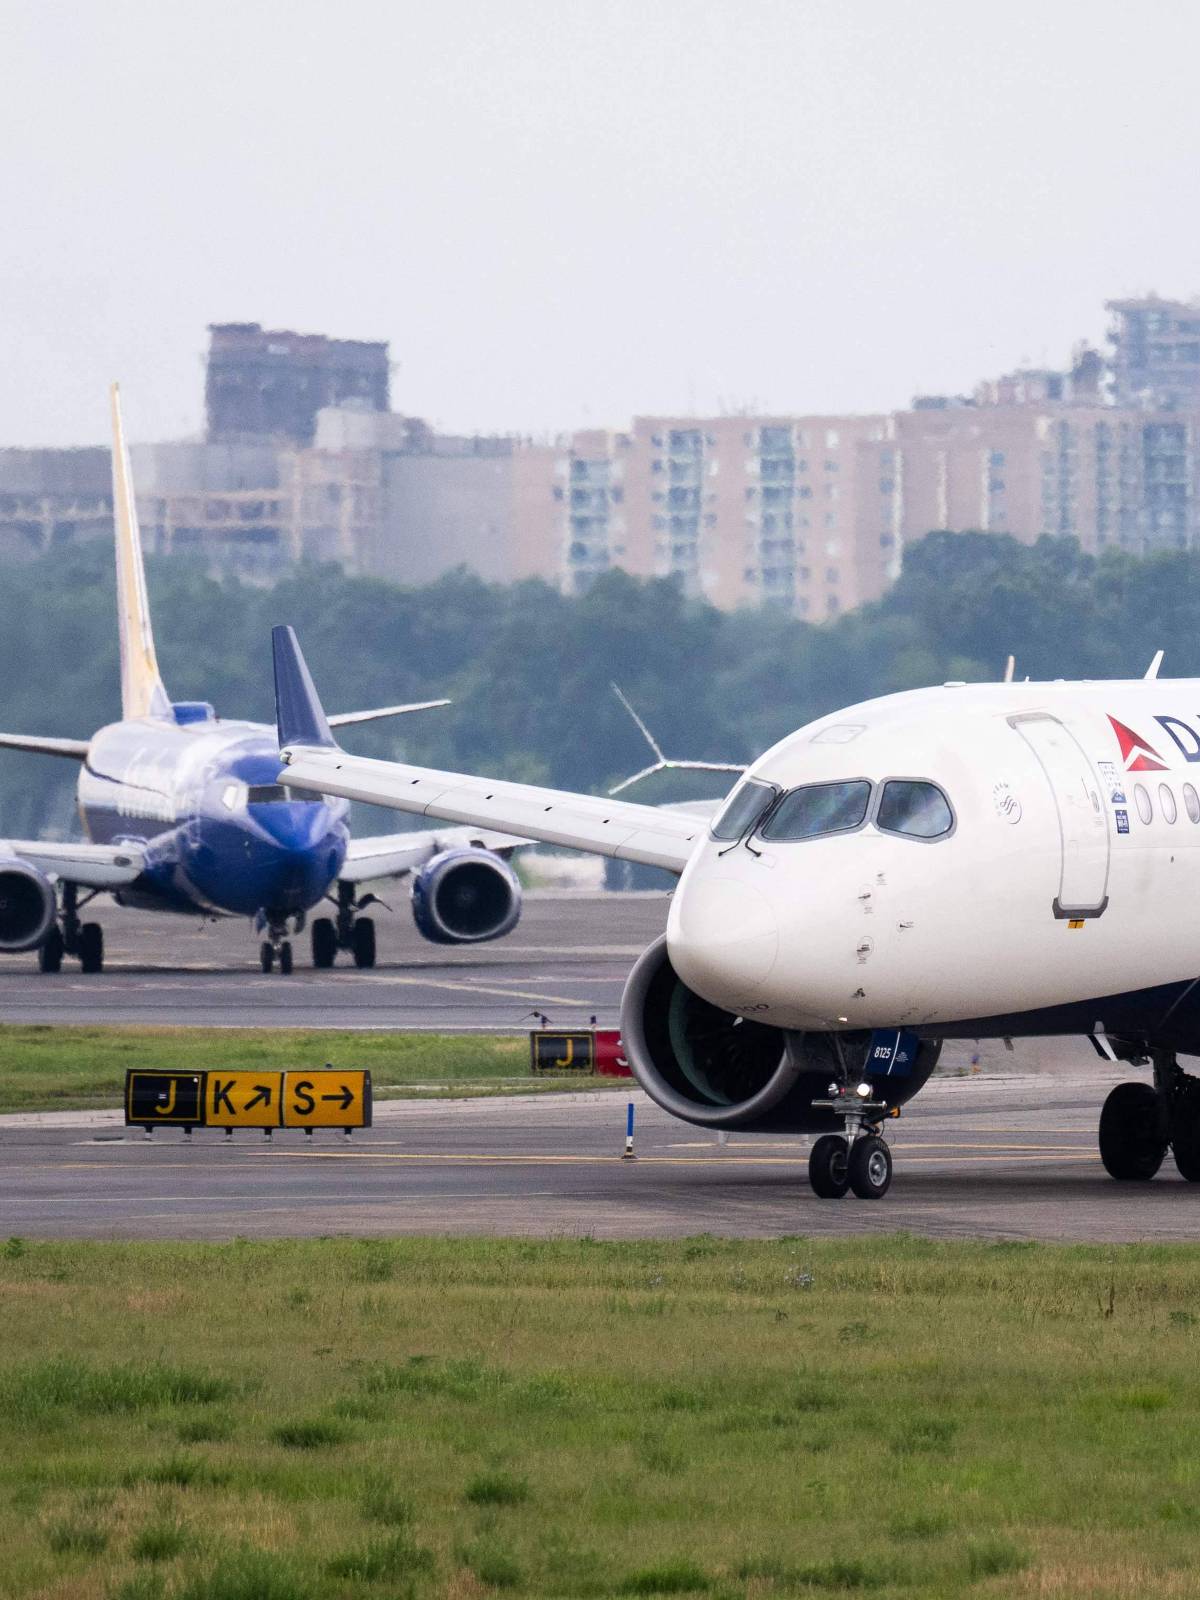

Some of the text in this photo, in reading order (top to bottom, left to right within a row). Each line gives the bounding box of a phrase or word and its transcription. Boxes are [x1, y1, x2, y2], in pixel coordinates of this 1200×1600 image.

[556, 1038, 575, 1067] J
[873, 1046, 892, 1059] 8125
[154, 1079, 316, 1116] J K S
